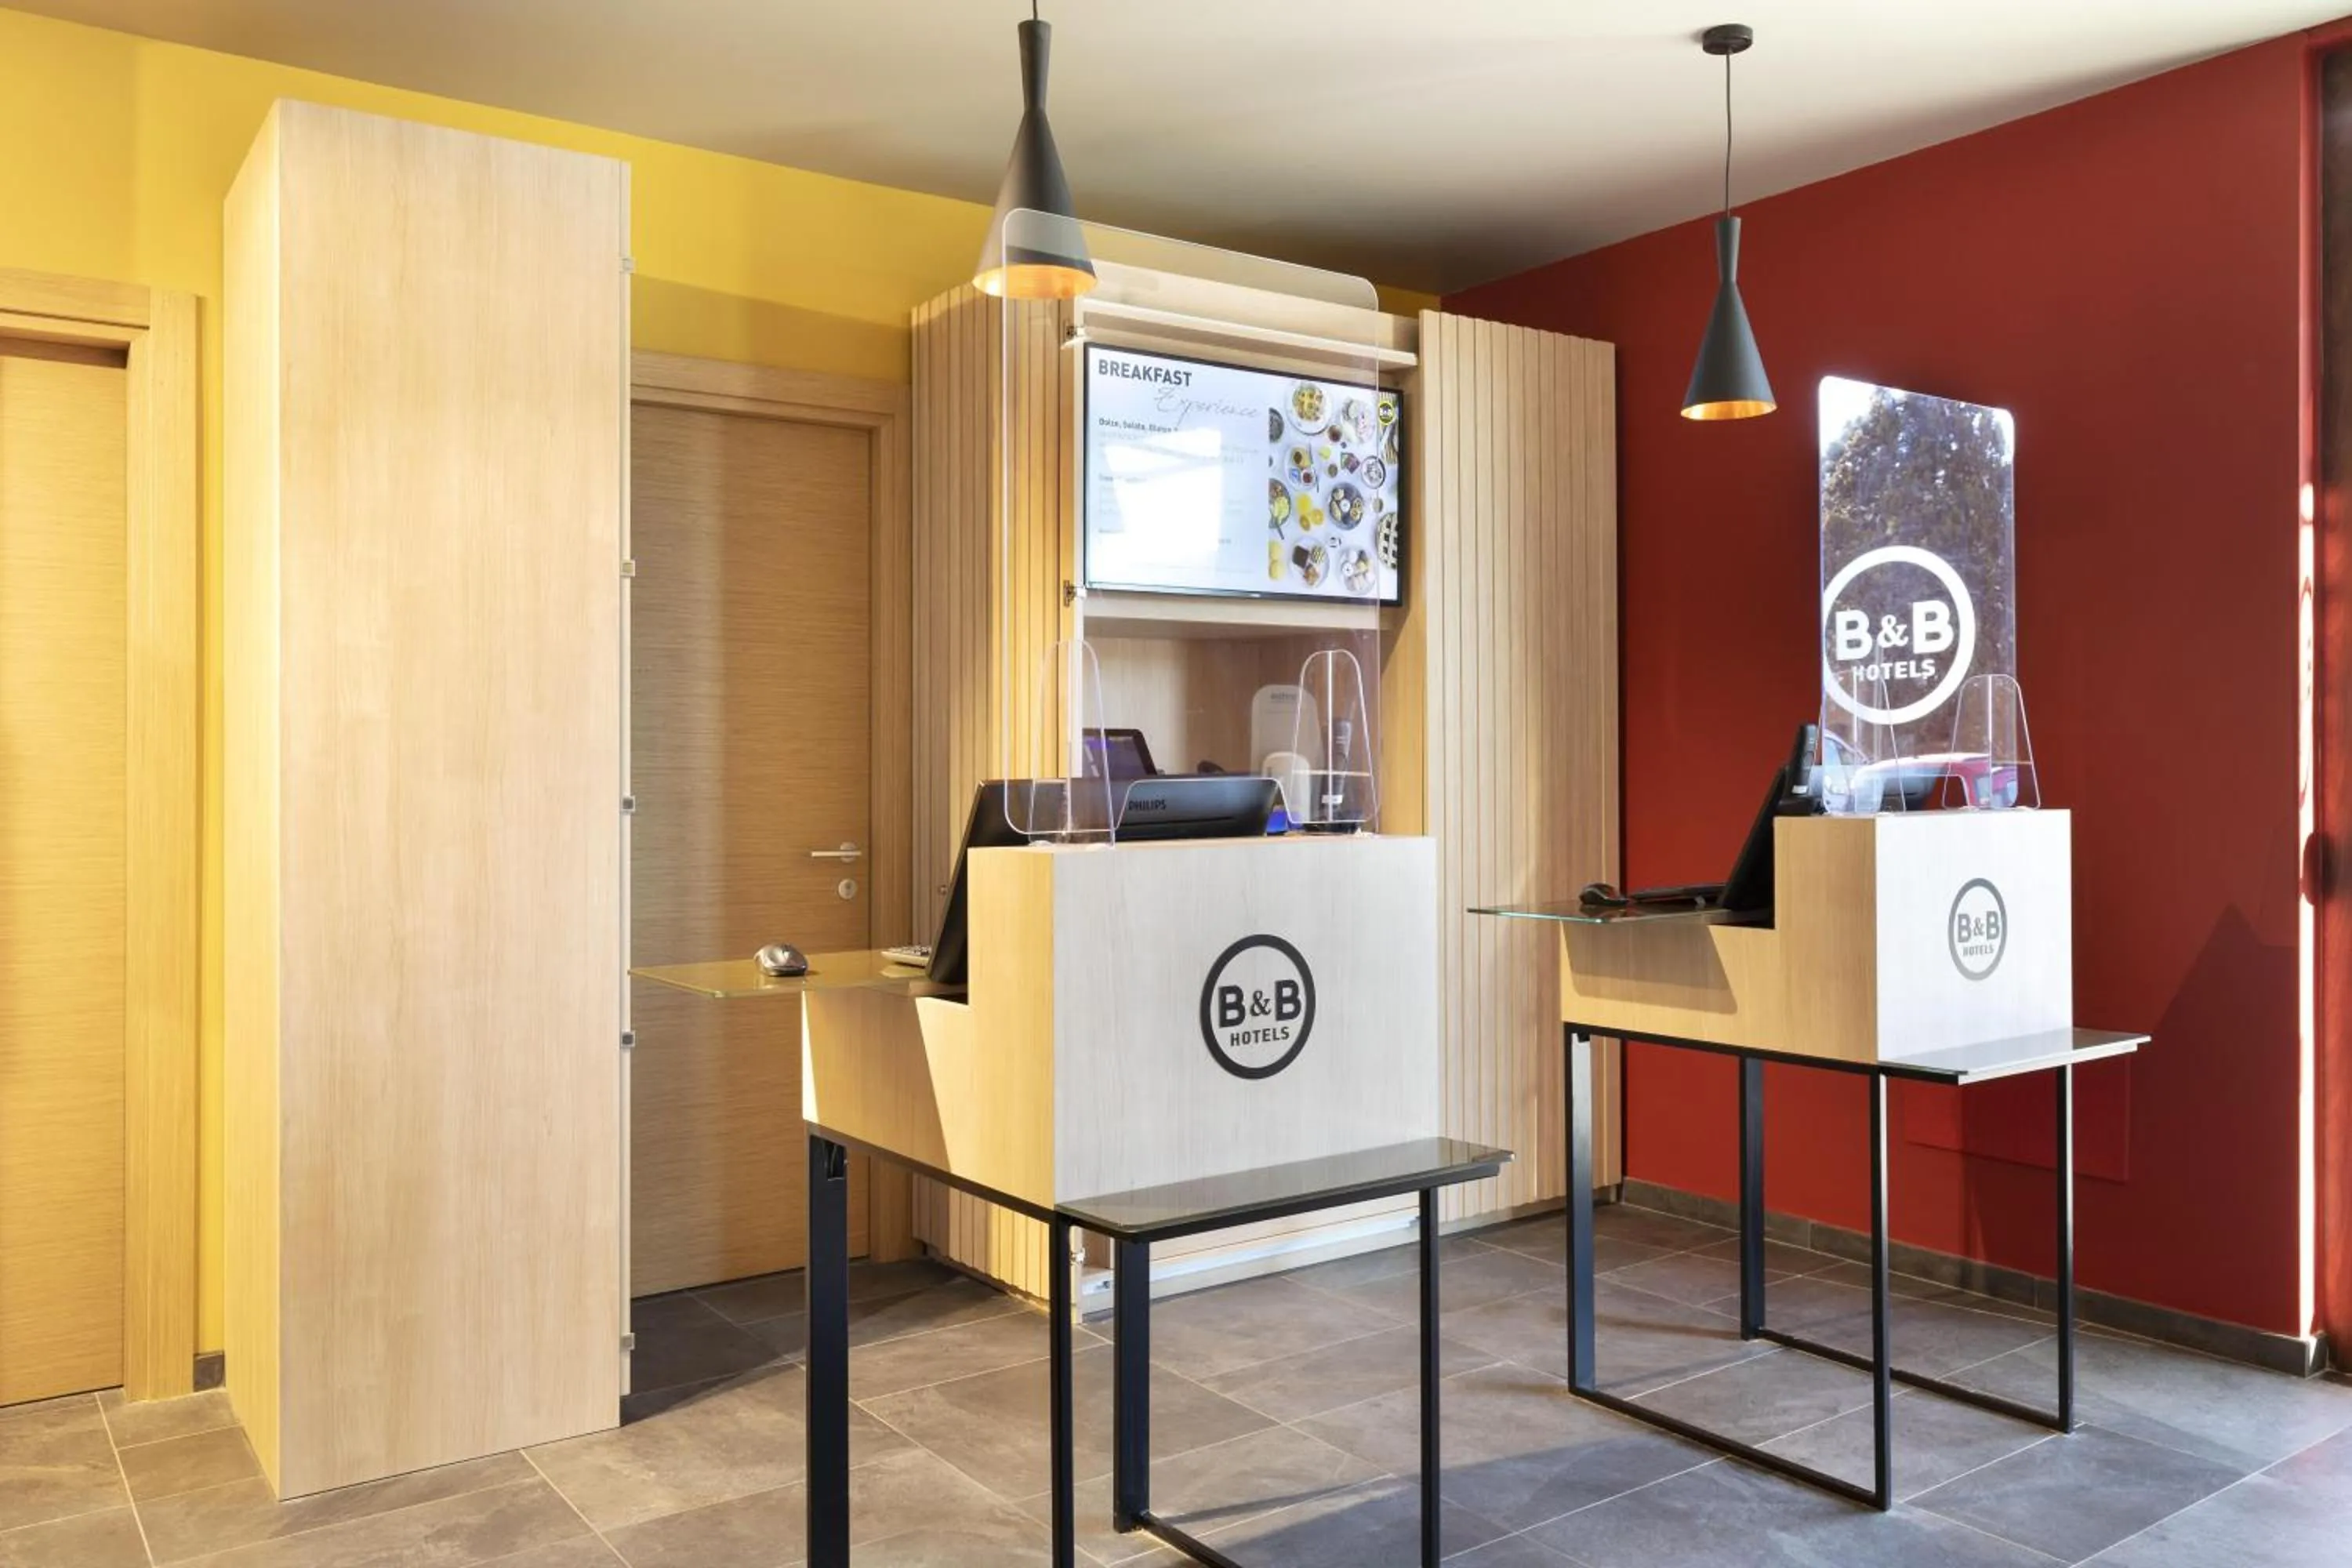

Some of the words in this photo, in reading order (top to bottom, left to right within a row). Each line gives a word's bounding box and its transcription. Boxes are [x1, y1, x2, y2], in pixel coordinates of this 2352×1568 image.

[1098, 359, 1192, 387] BREAKFAST
[1835, 600, 1954, 660] B&B
[1853, 659, 1936, 681] HOTELS
[1128, 800, 1166, 811] PHILIPS
[1958, 911, 2000, 943] B&B
[1962, 944, 1994, 956] HOTELS
[1218, 980, 1301, 1029] B&B
[1230, 1026, 1290, 1047] HOTELS
